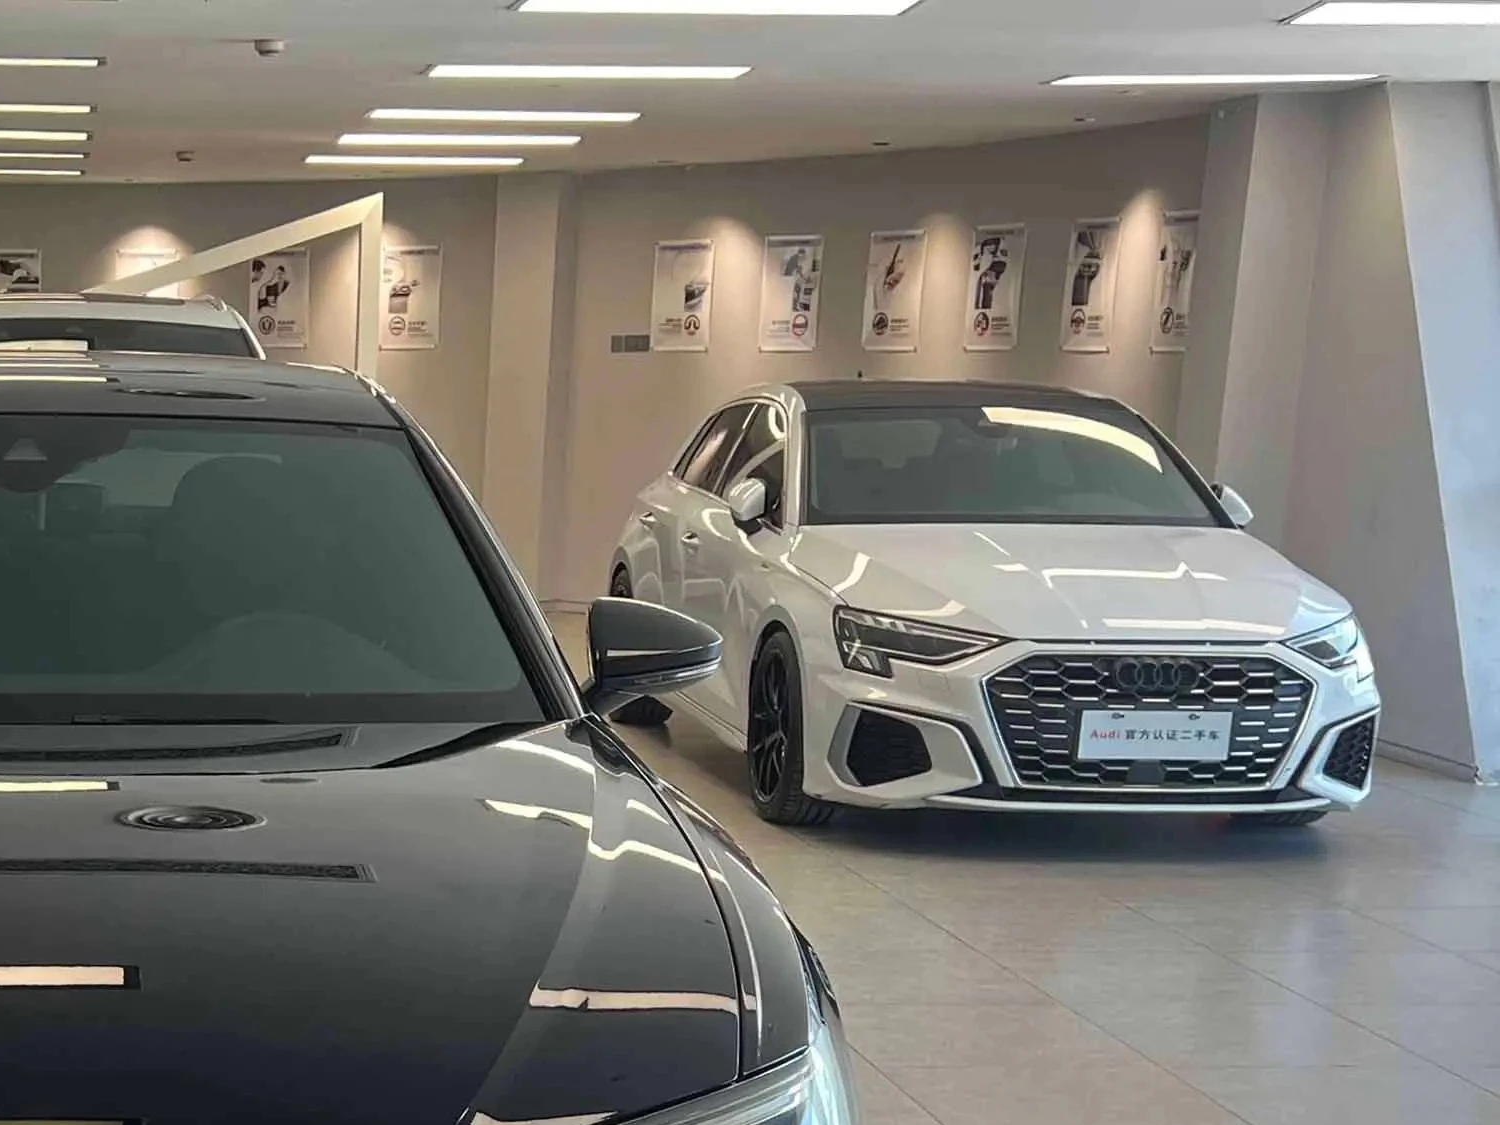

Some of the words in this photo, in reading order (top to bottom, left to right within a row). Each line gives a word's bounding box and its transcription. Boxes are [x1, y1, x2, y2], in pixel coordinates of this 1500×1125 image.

[1090, 729, 1120, 739] Audi
[1125, 729, 1220, 741] 官方认证二手车
